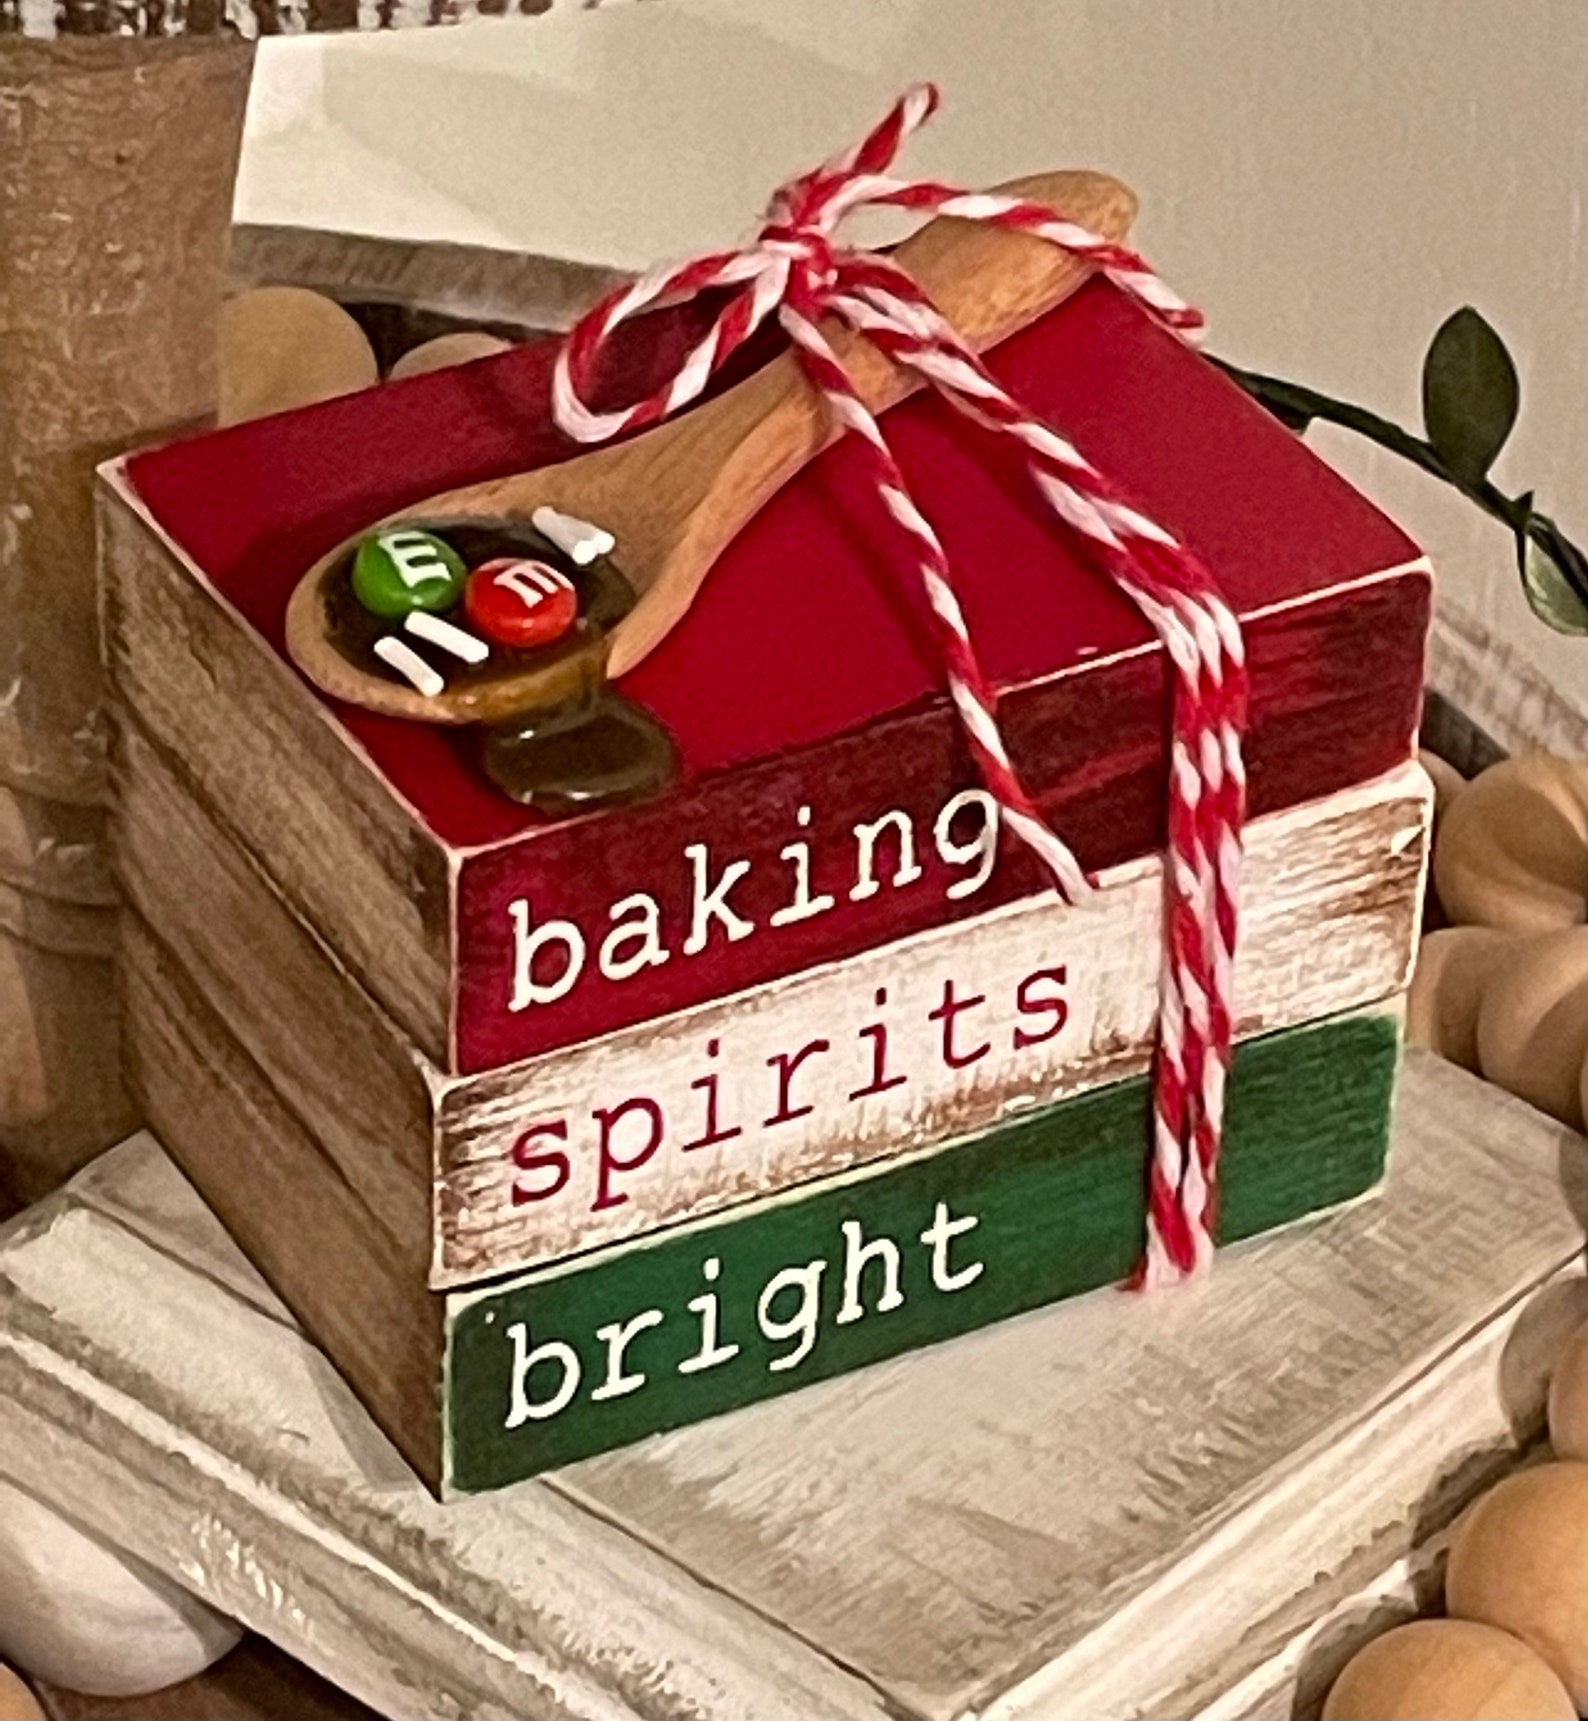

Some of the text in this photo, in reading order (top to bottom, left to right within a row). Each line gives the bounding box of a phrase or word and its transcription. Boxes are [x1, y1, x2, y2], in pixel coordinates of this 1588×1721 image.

[378, 531, 452, 588] m
[493, 559, 574, 608] m
[507, 789, 999, 1013] baking
[510, 965, 1069, 1212] spirits
[505, 1202, 984, 1429] bright
